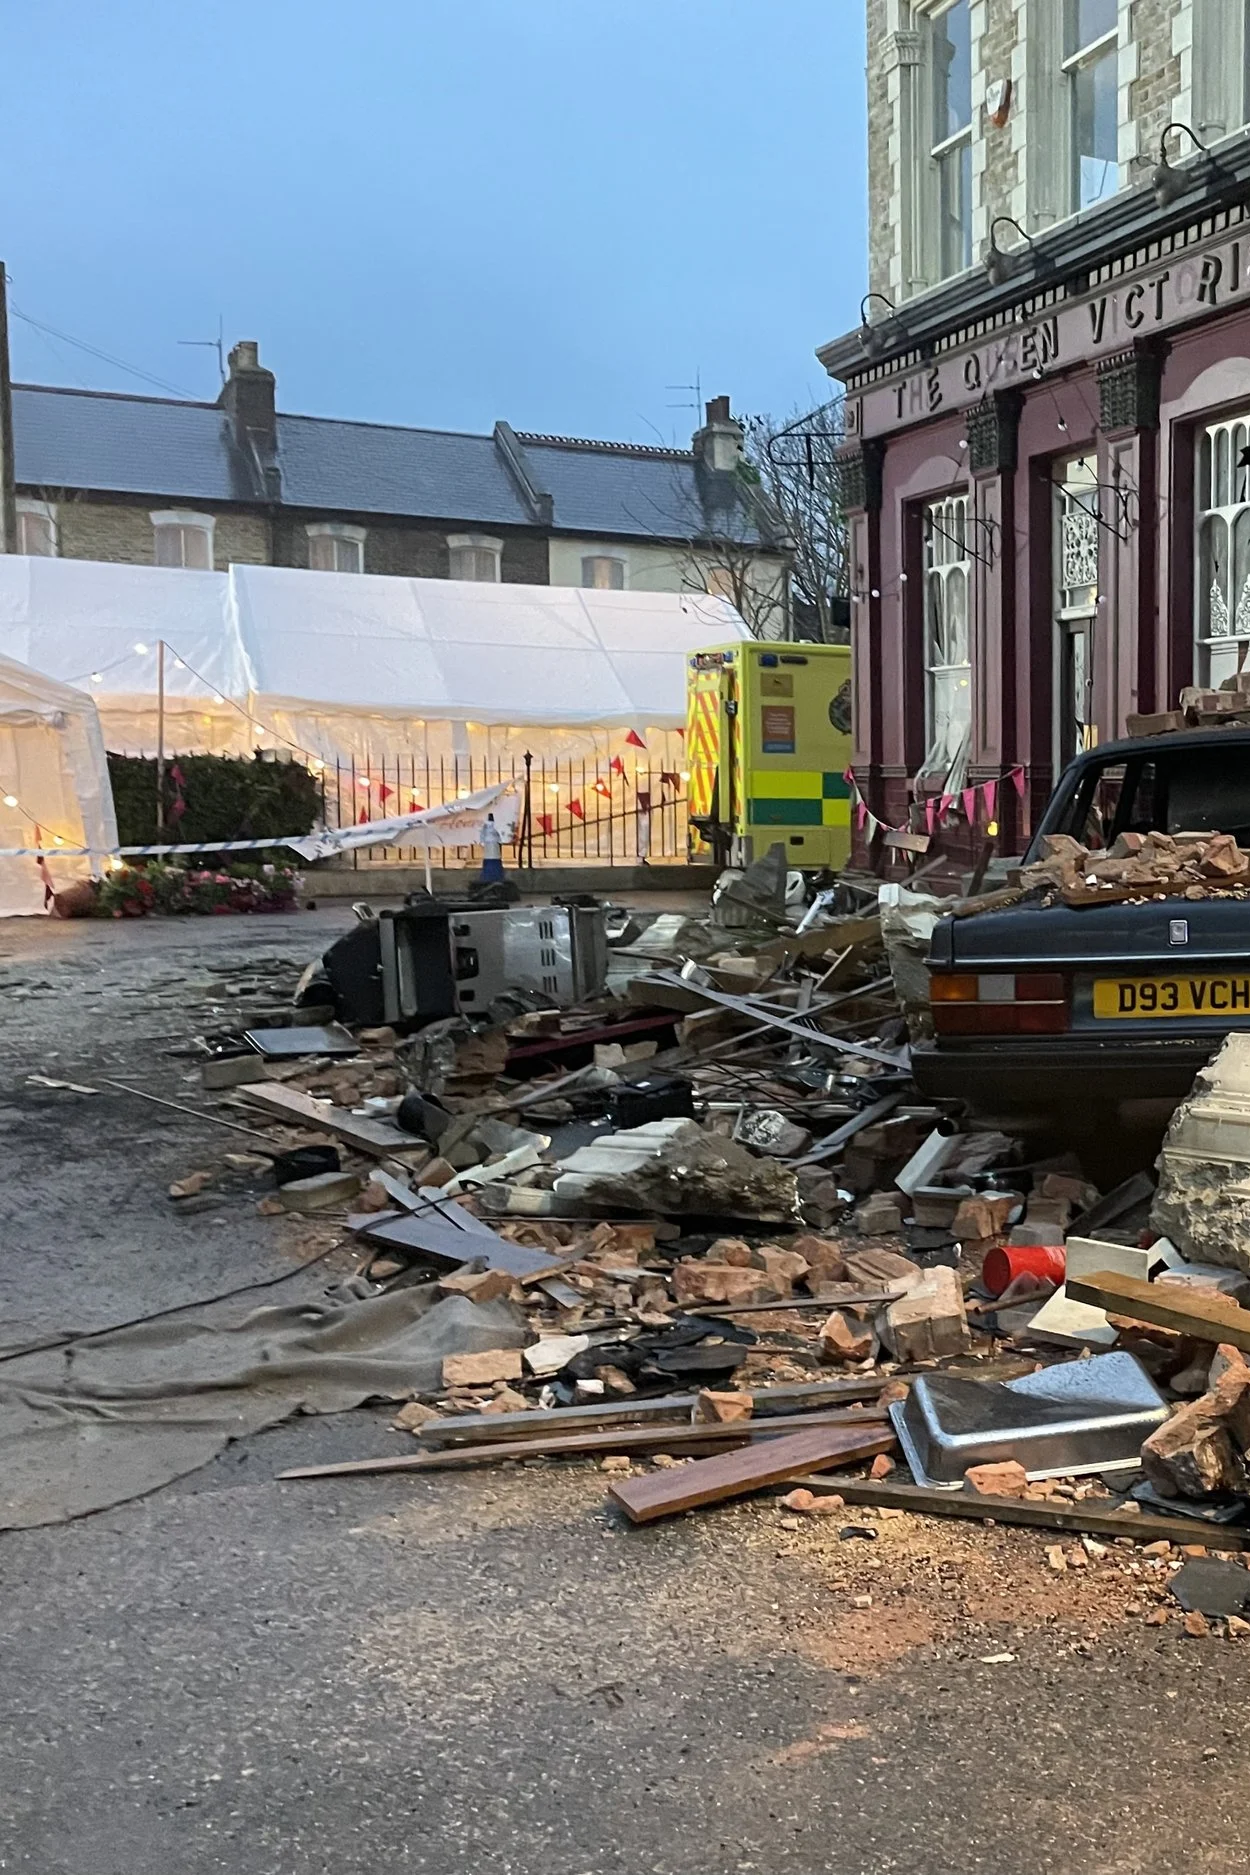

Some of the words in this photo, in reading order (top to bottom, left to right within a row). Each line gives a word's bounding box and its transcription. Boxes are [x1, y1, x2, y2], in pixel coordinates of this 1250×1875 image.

[892, 366, 943, 418] THE
[1118, 982, 1179, 1012] D93
[1189, 979, 1250, 1010] VCH
